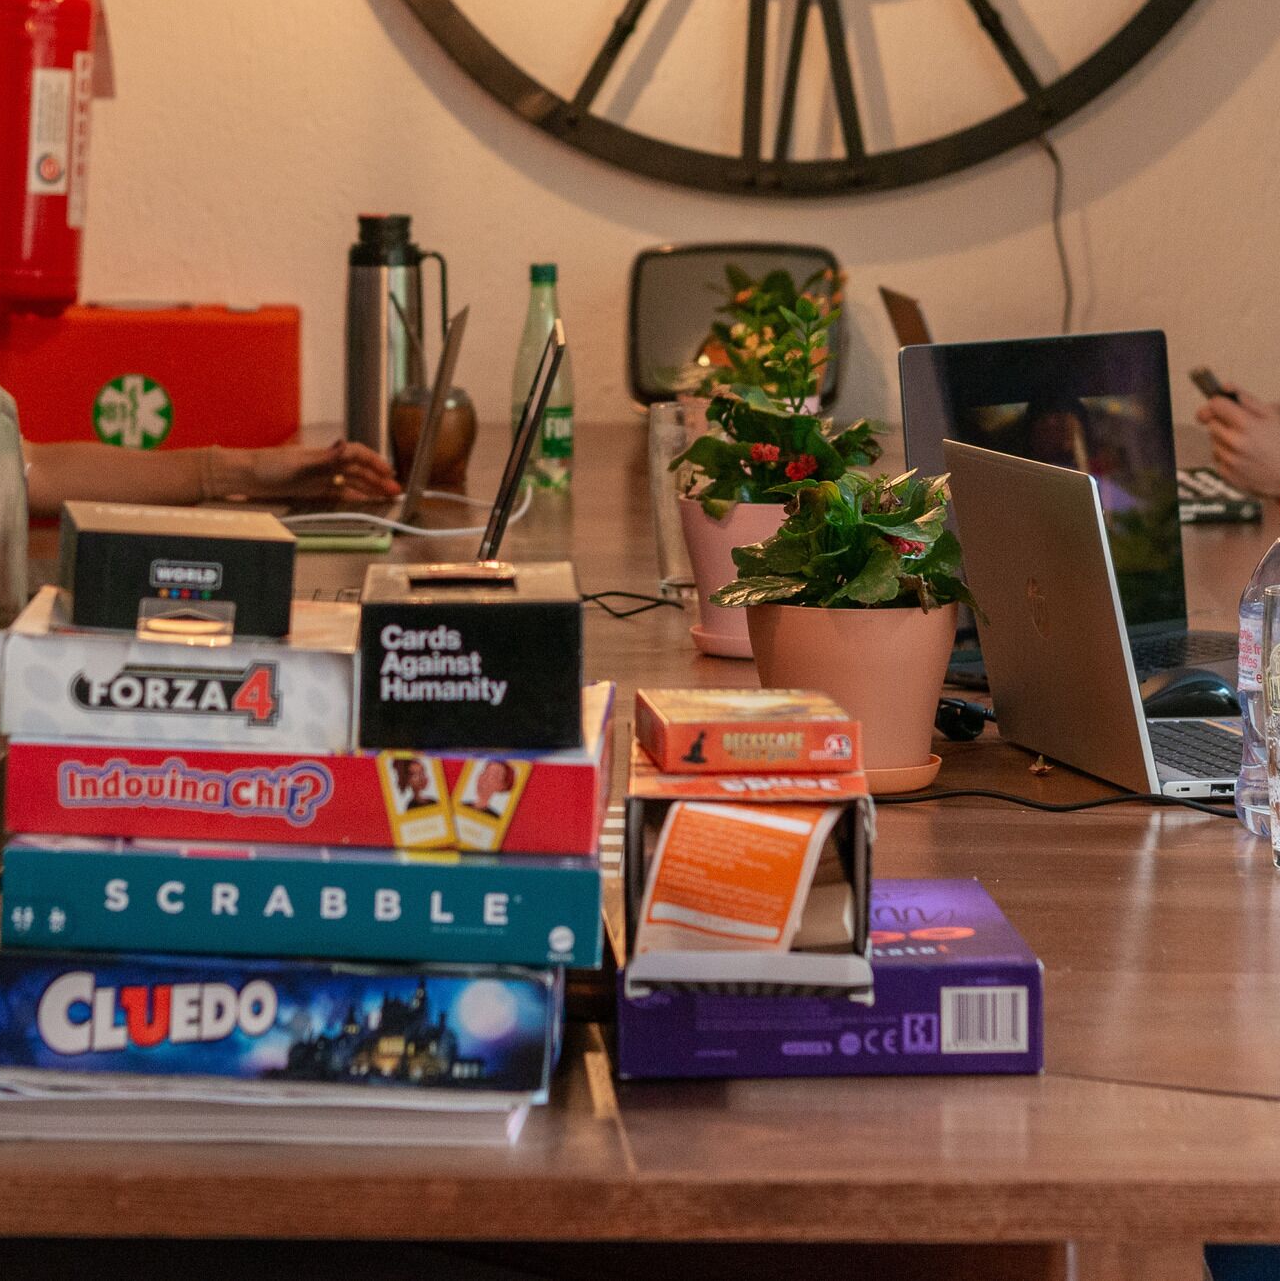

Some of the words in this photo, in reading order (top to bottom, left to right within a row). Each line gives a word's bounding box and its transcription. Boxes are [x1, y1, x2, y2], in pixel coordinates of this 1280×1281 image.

[156, 567, 219, 585] WORLD
[381, 624, 461, 650] Cards
[381, 651, 481, 680] Against
[86, 674, 229, 712] FORZA
[232, 668, 275, 720] 4
[381, 676, 507, 706] Humanity
[67, 768, 221, 805] Indovina
[103, 878, 510, 926] SCRABBLE
[36, 970, 278, 1056] CLUEDO
